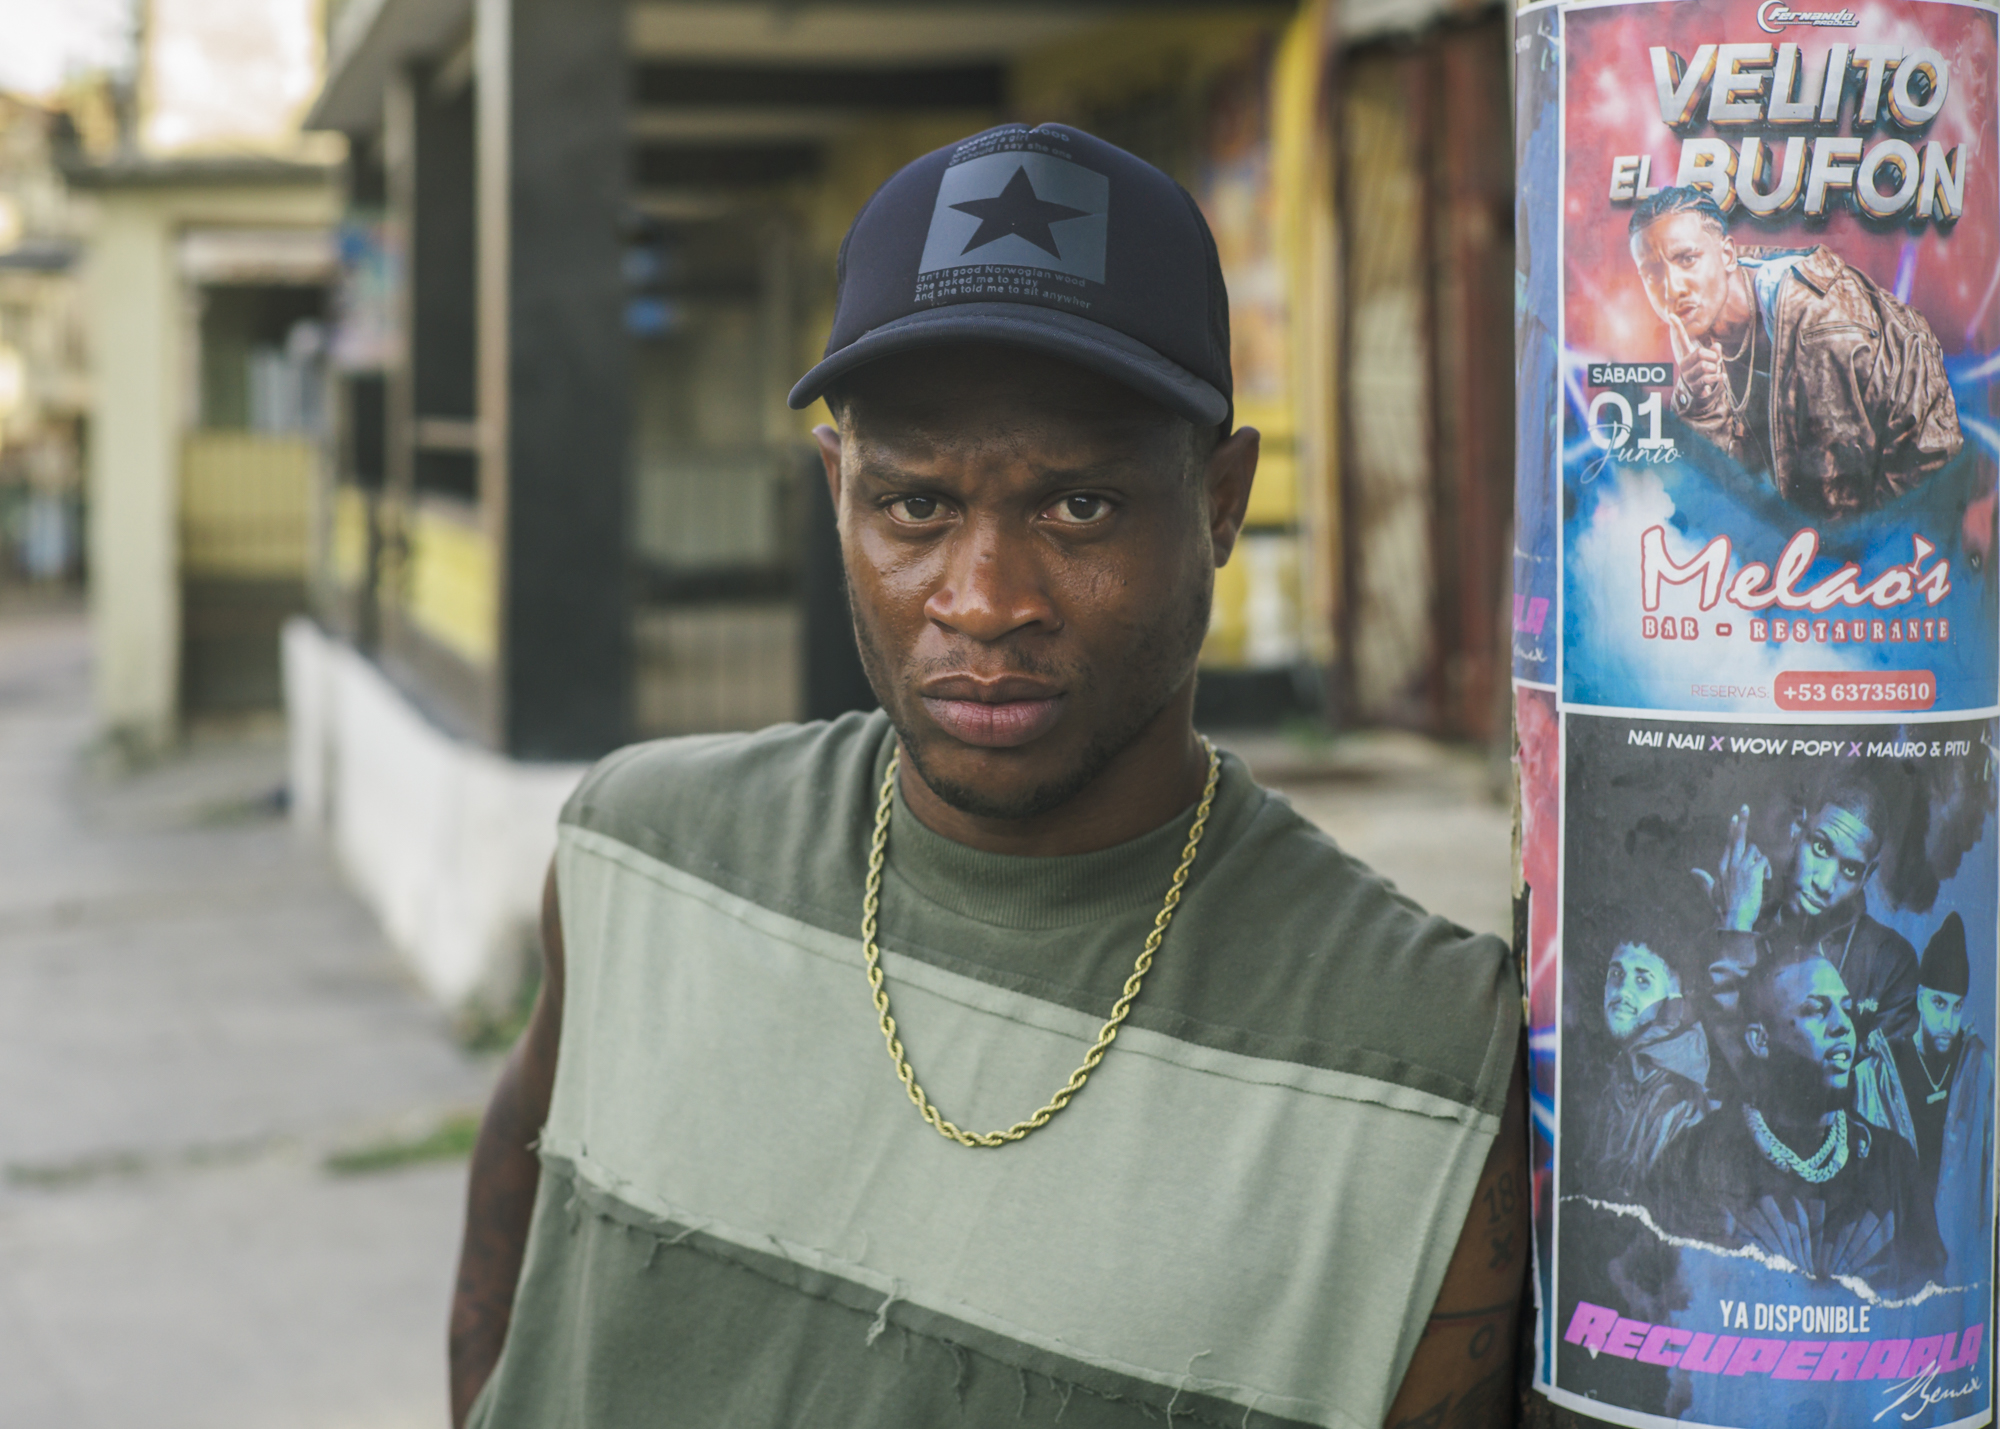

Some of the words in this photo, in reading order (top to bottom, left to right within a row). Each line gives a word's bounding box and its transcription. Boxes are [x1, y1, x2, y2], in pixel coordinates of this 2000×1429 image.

[1767, 7, 1855, 21] Fernando
[1649, 42, 1949, 130] VELITO
[1609, 154, 1660, 201] EL
[1675, 136, 1967, 222] BUFON
[915, 282, 935, 293] She
[938, 275, 973, 288] asked
[976, 276, 994, 284] me
[997, 275, 1009, 284] to
[1013, 276, 1039, 288] stay
[952, 266, 982, 277] good
[1055, 273, 1087, 288] wood
[914, 290, 935, 302] And
[937, 287, 957, 297] she
[960, 284, 983, 294] told
[987, 285, 1004, 293] me
[1008, 285, 1020, 294] to
[1023, 286, 1039, 296] sit
[1592, 362, 1666, 384] SÁBADO
[1588, 391, 1674, 450] 01
[1580, 420, 1682, 484] Junio
[1642, 616, 1699, 641] BAR
[1750, 618, 1949, 643] RESTAURANTE
[1691, 684, 1770, 699] RESERVAS:
[1783, 683, 1826, 701] +53
[1831, 683, 1930, 701] 63735610
[1627, 729, 1663, 748] NAII
[1666, 732, 1705, 750] NAII
[1708, 736, 1725, 752] X
[1730, 737, 1788, 755] WOW
[1791, 740, 1845, 757] POPY
[1848, 741, 1863, 757] X
[1866, 741, 1927, 757] MAURO
[1929, 741, 1941, 757] &
[1944, 740, 1971, 757] PITU
[1720, 1300, 1749, 1329] YA
[1754, 1303, 1870, 1333] DISPONIBLE
